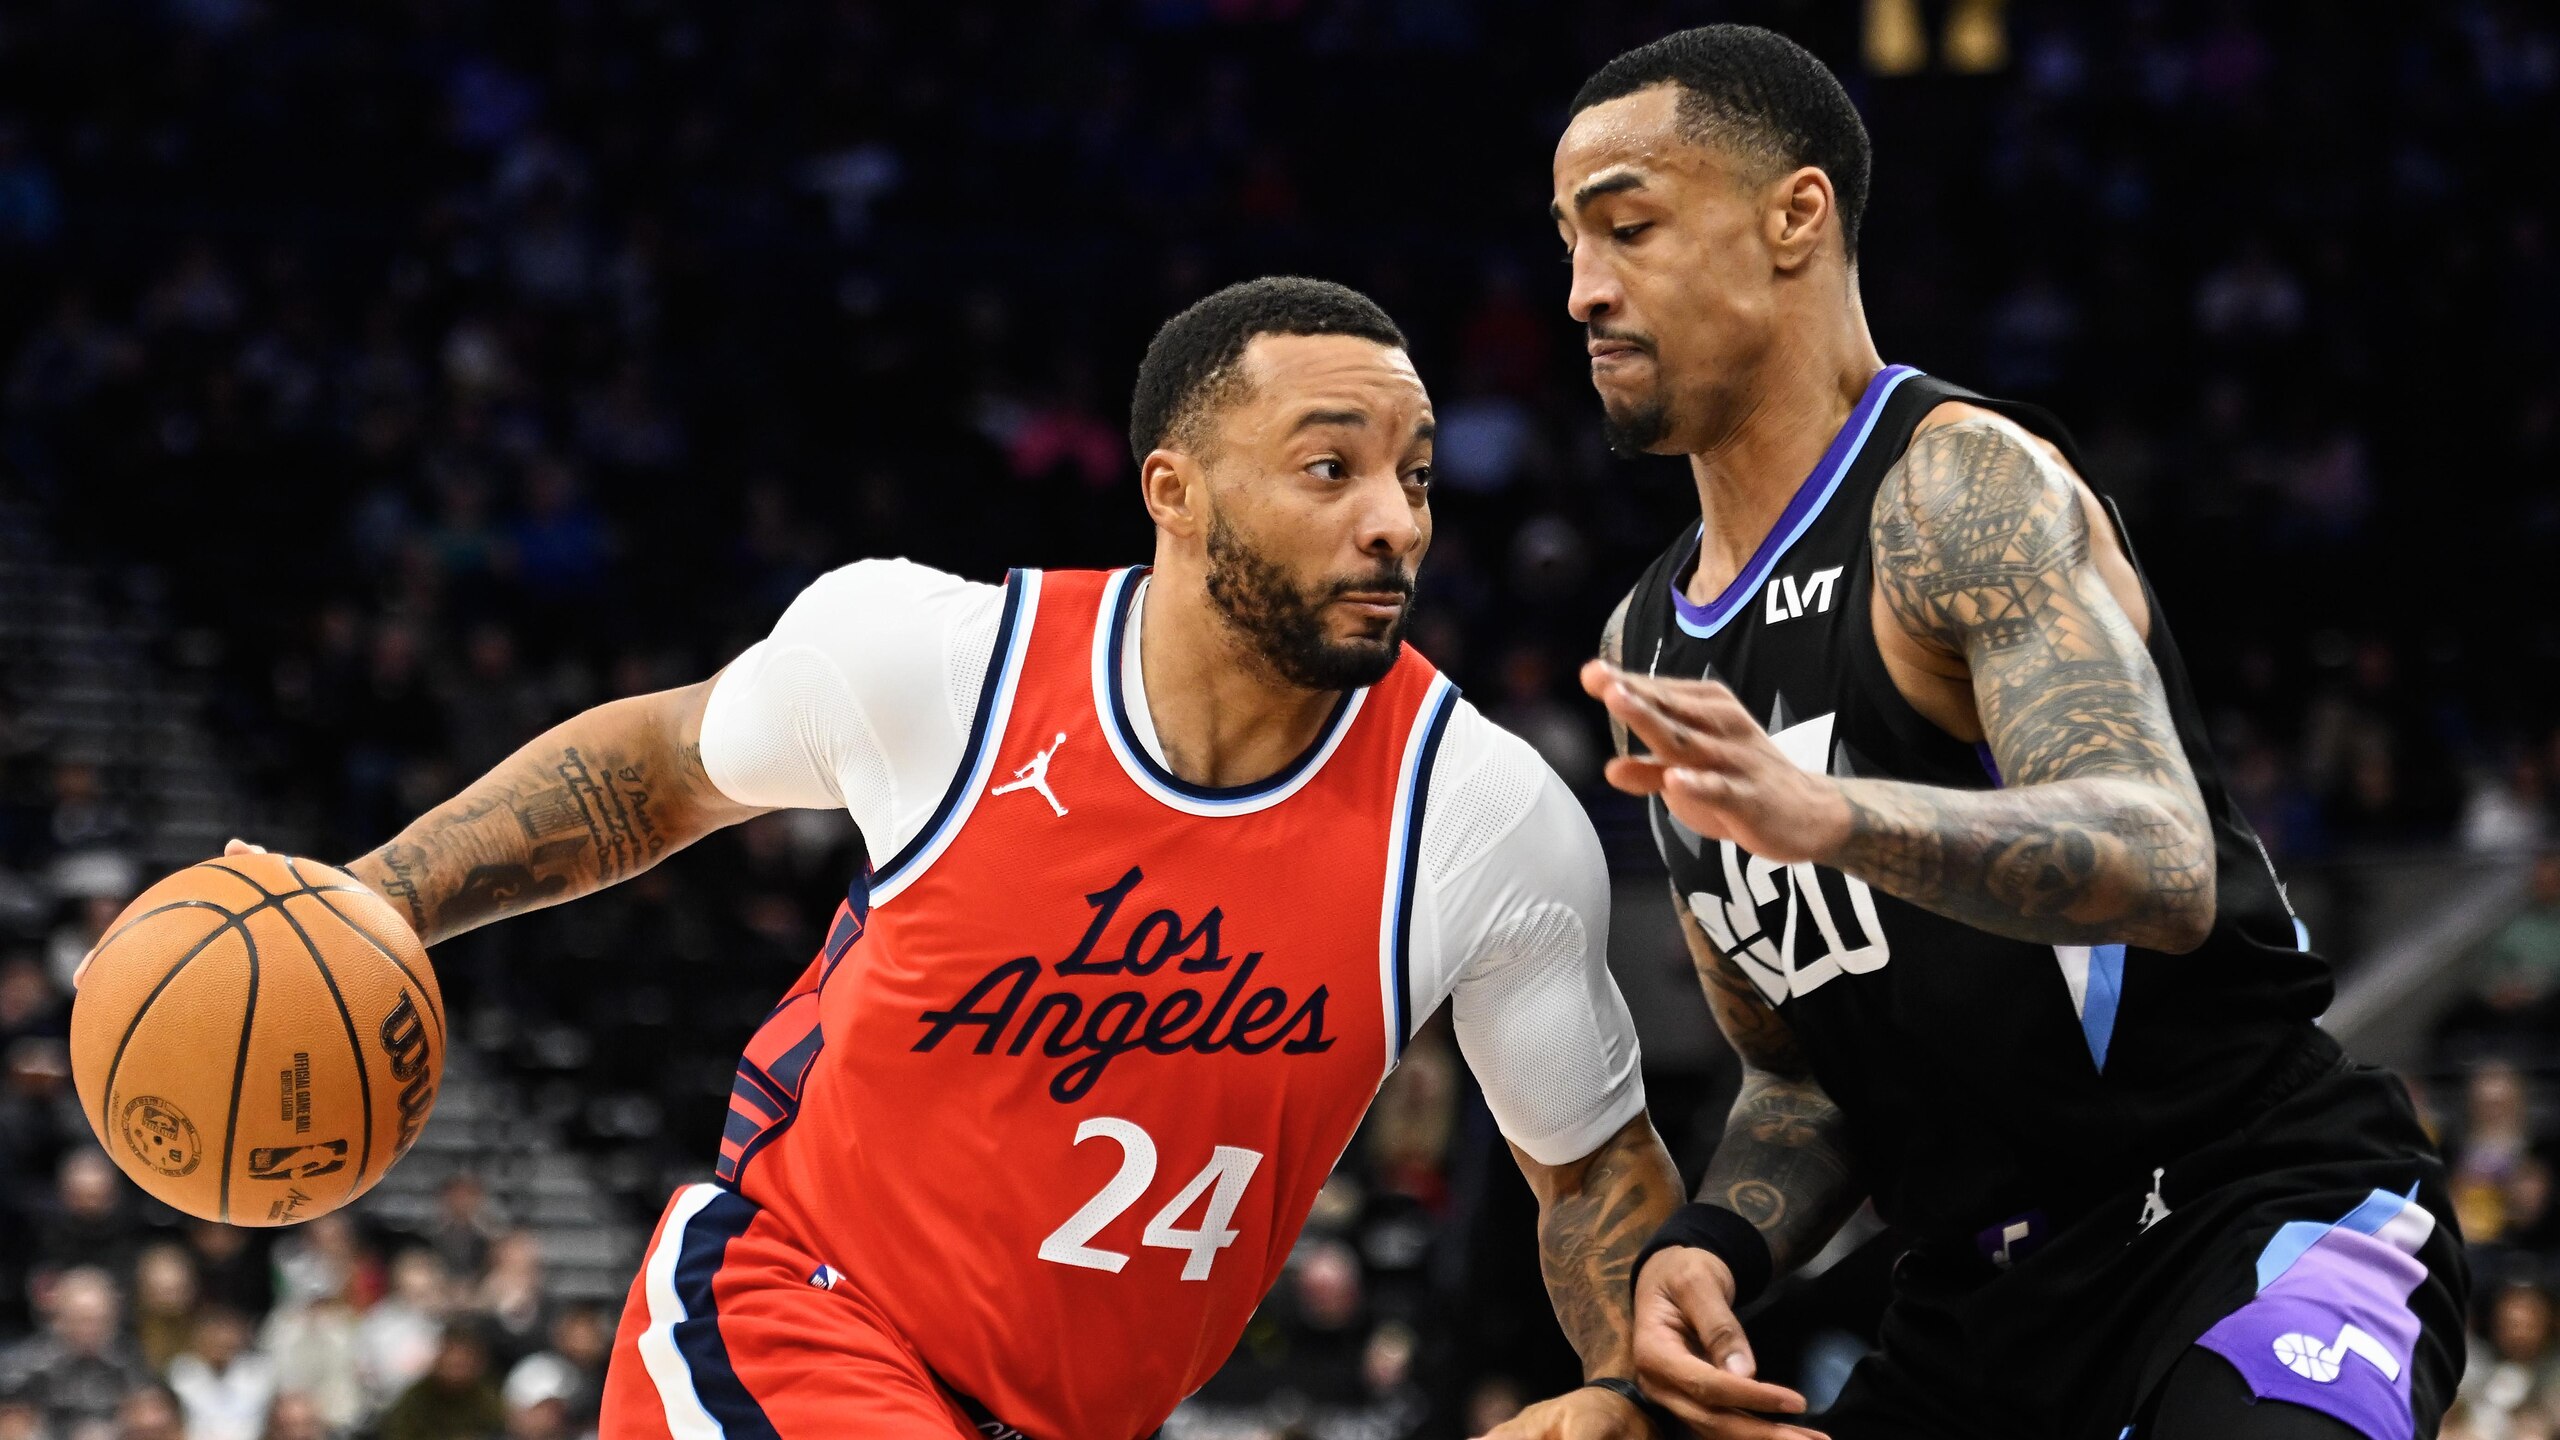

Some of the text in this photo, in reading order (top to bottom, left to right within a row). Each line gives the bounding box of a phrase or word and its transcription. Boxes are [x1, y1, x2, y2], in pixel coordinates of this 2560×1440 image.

[1765, 565, 1844, 625] LVT
[1053, 865, 1234, 977] Los
[1746, 854, 1890, 999] 20
[910, 952, 1338, 1104] Angeles
[293, 1053, 311, 1134] OFFICIAL GAME BALL
[1037, 1116, 1264, 1281] 24
